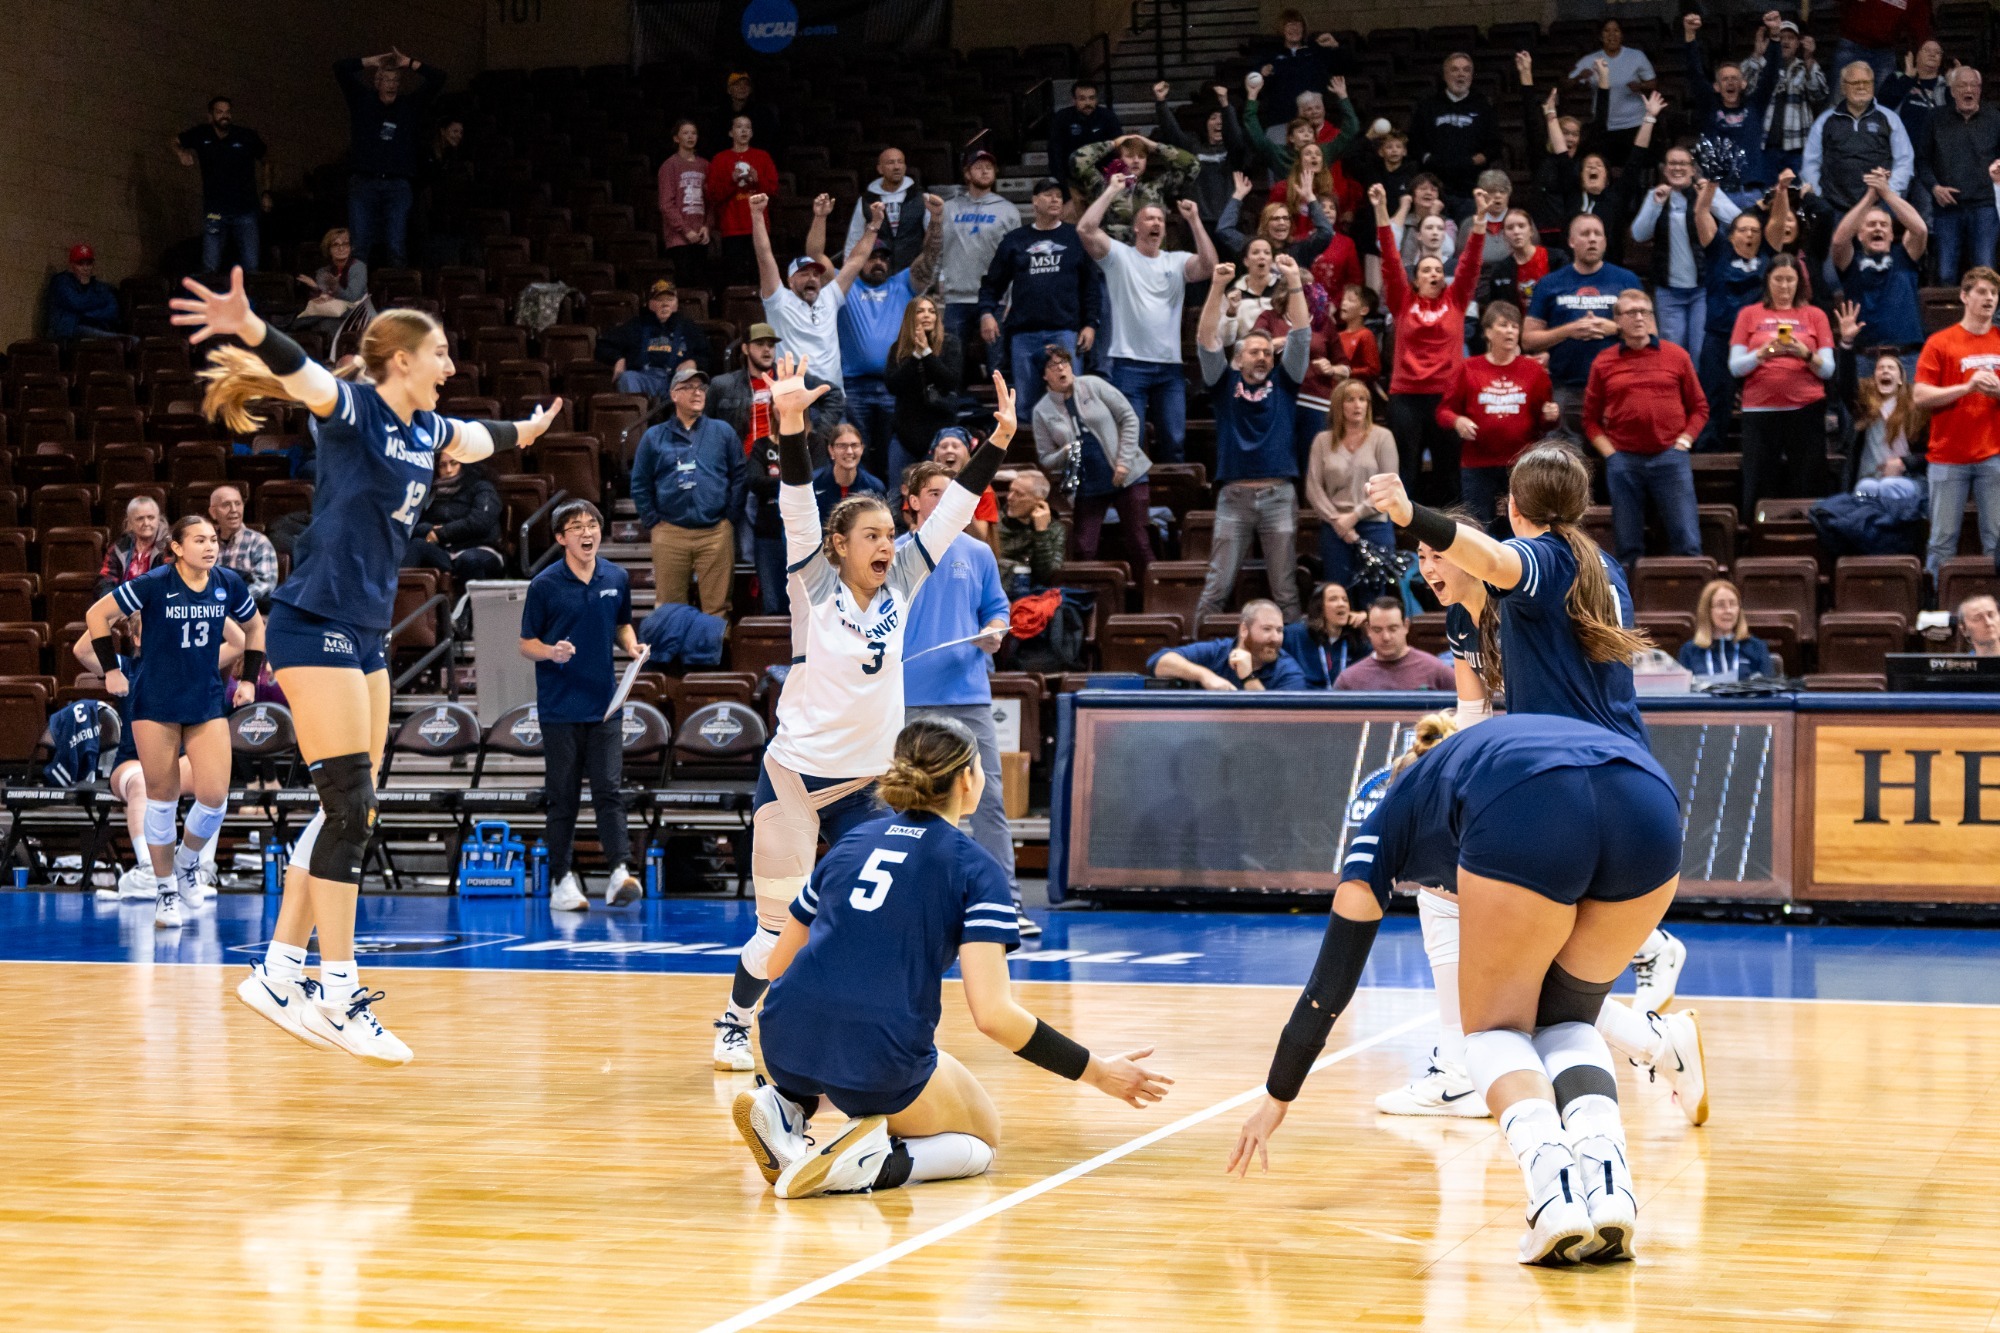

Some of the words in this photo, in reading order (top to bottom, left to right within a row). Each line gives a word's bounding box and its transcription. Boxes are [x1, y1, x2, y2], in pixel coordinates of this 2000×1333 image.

[747, 21, 796, 38] NCAA
[954, 213, 996, 223] LIONS
[1030, 254, 1062, 267] MSU
[1029, 266, 1060, 275] DENVER
[391, 480, 426, 525] 12
[166, 606, 187, 618] MSU
[191, 605, 225, 618] DENVER
[181, 621, 209, 648] 13
[325, 637, 353, 651] MSU
[862, 641, 887, 675] 3
[74, 703, 87, 723] 3
[890, 827, 923, 836] RMAC
[467, 878, 512, 886] POWERADE
[849, 848, 908, 912] 5
